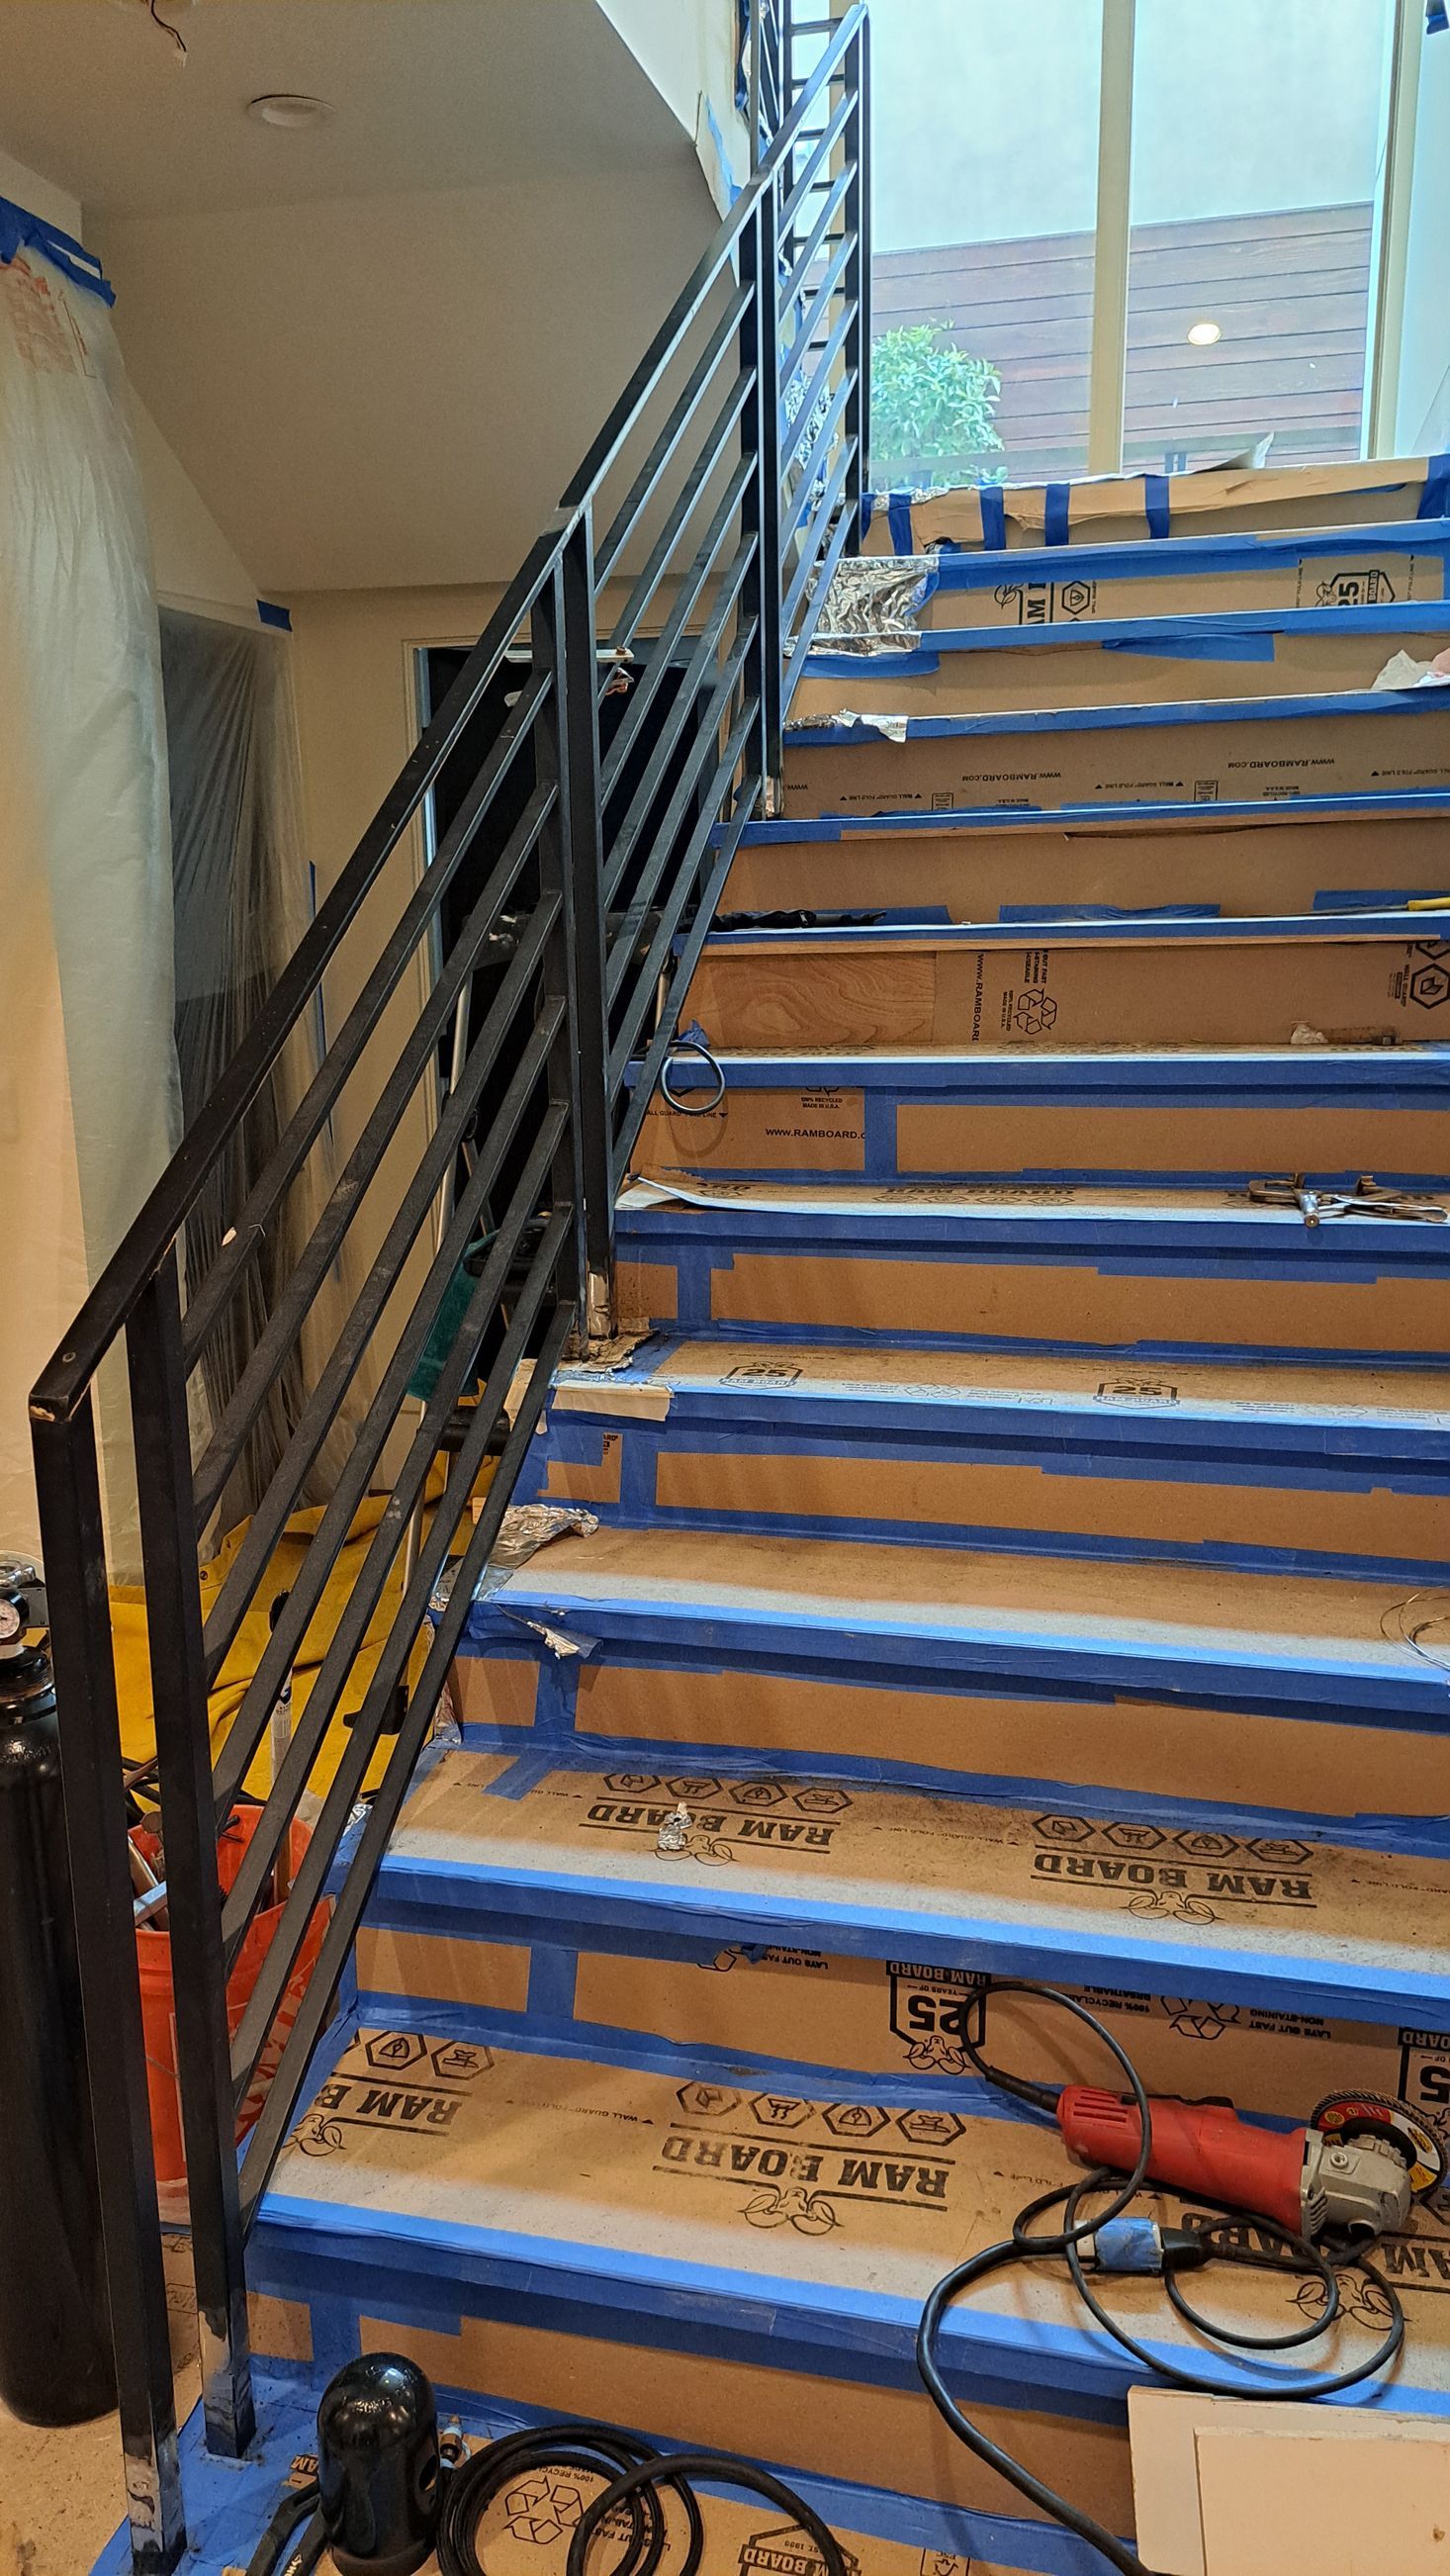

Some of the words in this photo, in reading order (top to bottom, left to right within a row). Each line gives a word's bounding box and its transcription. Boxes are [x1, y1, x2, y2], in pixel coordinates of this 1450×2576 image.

[1368, 571, 1379, 600] BOARD
[742, 1368, 786, 1378] 25
[1113, 1386, 1162, 1395] 25
[737, 1818, 836, 1846] RAM
[1034, 1853, 1188, 1888] BOARD
[1207, 1872, 1313, 1899] RAM
[782, 1957, 802, 1966] OUT
[804, 1960, 829, 1970] LAYS
[890, 1962, 945, 1980] BOARD
[951, 1969, 987, 1987] RAM
[932, 1986, 958, 1996] YEARS
[1083, 1984, 1151, 2001] BREATHABLE
[907, 1994, 966, 2036] 25
[1125, 2002, 1150, 2013] 100%
[1249, 2008, 1324, 2026] NON-STAINING
[1249, 2020, 1276, 2031] FAST
[1278, 2024, 1301, 2035] OUT
[1304, 2027, 1331, 2039] LAYS
[355, 2089, 463, 2126] RAM
[612, 2112, 638, 2122] WALL
[661, 2135, 824, 2182] BOARD
[837, 2158, 951, 2198] RAM
[574, 2472, 594, 2483] 100%
[743, 2547, 808, 2573] BOARD
